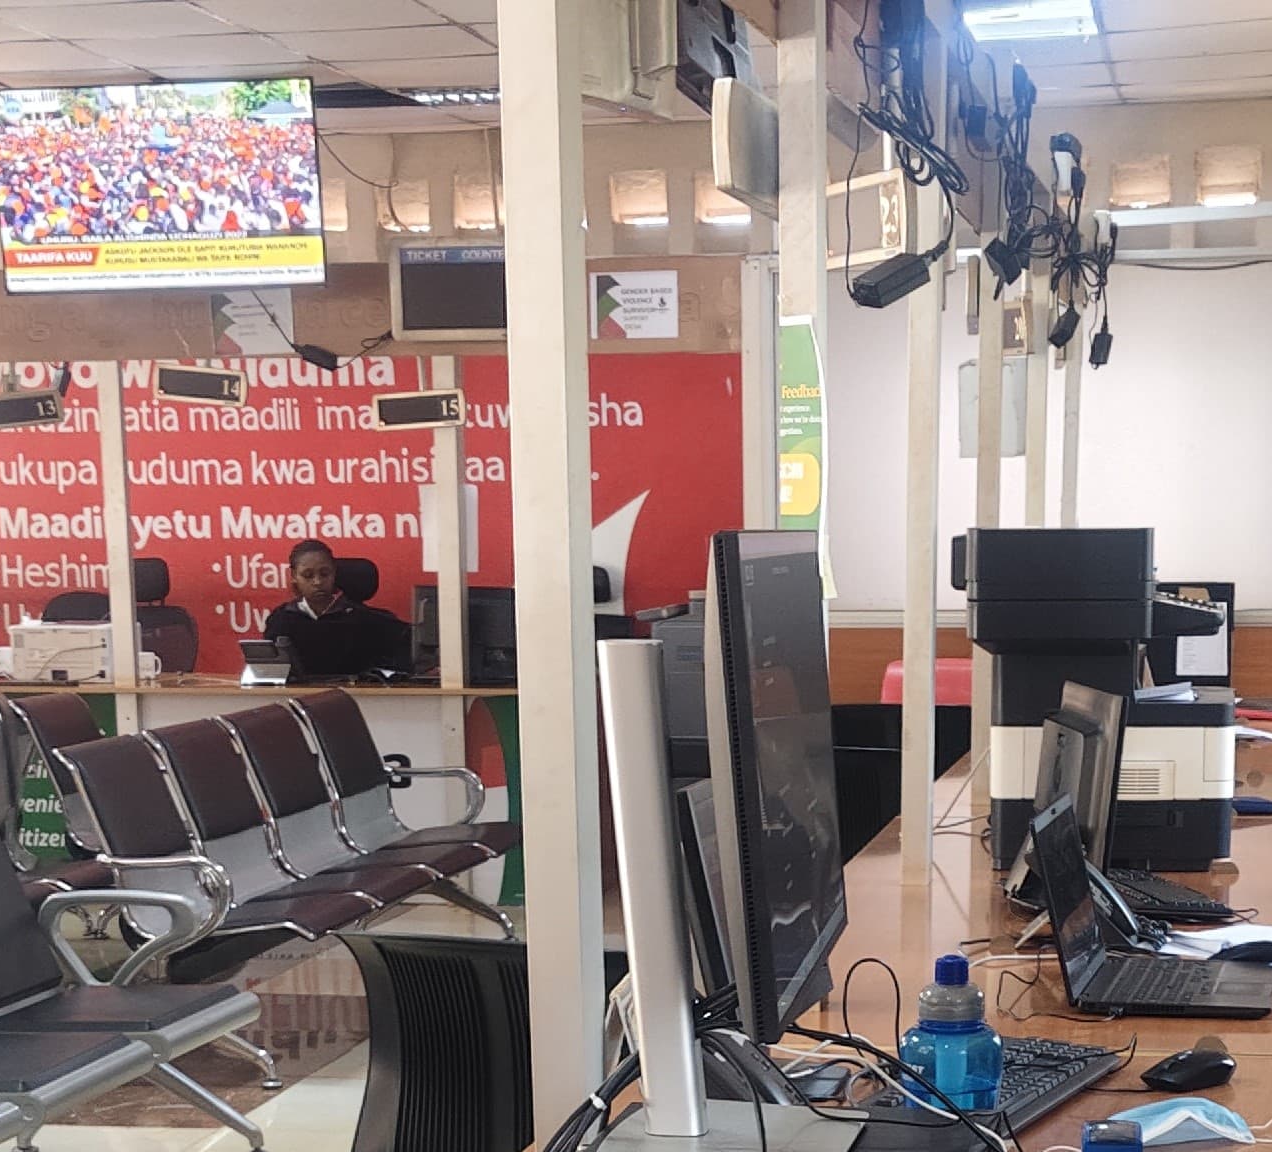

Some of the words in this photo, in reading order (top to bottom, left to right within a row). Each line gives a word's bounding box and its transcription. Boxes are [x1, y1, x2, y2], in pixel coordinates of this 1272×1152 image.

[15, 250, 66, 264] TAARIFA
[67, 250, 94, 262] KUU
[407, 249, 447, 261] TICKET
[461, 248, 505, 260] COUNTE
[222, 378, 240, 397] 14
[36, 399, 57, 417] 13
[189, 398, 301, 431] maadili
[317, 396, 377, 430] ima
[440, 399, 459, 417] 15
[127, 451, 243, 486] uduma
[250, 450, 315, 485] kwa
[325, 447, 437, 484] urahisi
[131, 509, 212, 551] yetu
[220, 505, 386, 539] Mwafaka
[0, 553, 110, 589] Heshim
[229, 601, 272, 634] Uw
